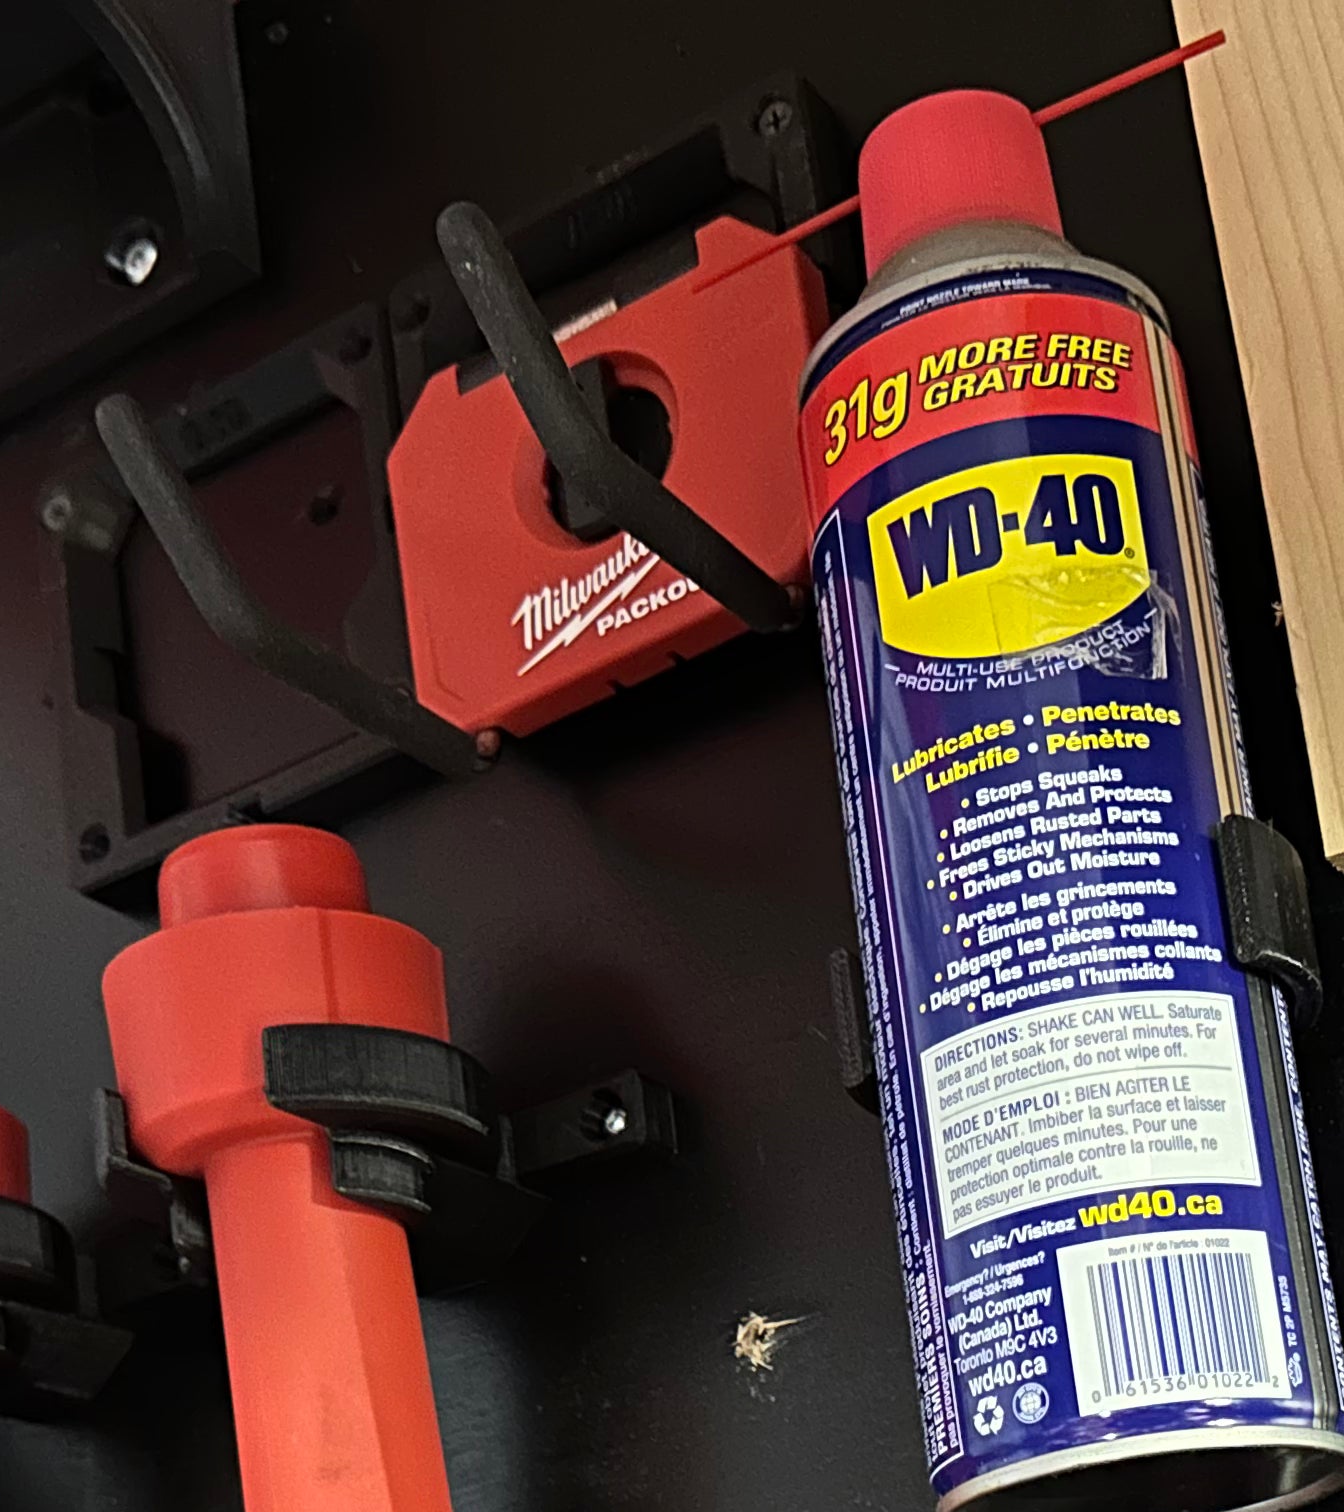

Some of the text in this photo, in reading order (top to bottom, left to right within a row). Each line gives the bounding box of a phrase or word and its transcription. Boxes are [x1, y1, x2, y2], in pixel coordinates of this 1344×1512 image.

[918, 333, 1132, 384] MORE FREE
[923, 363, 1118, 411] GRATUITS
[825, 371, 909, 466] 31g
[886, 473, 1125, 599] WD-40
[895, 622, 1152, 693] PRODUIT MULTIFONCTION
[917, 619, 1125, 677] MULTI-USE PRODUCT
[892, 701, 1182, 783] Lubricates Penetrates
[925, 728, 1150, 793] Lubrifie Pénètre
[953, 785, 1173, 837] Removes And Protects
[976, 765, 1123, 807] Stops Squeaks
[939, 827, 1179, 888] Frees Sticky Mechanisms
[950, 806, 1162, 860] Loosens Rusted Parts
[956, 878, 1177, 933] Arrête les grincements
[963, 852, 1160, 900] Drives Out Moisture
[947, 920, 1198, 980] Dégage les pièces rouillées
[978, 900, 1144, 946] Élimine et protège
[930, 941, 1223, 1012] Dégage les mécanismes collants
[982, 962, 1175, 1012] Repousse l'humidité
[935, 1002, 1222, 1072] DIRECTIONS: SHAKE CAN WELL. Saturate
[937, 1024, 1217, 1092] area and let soak for several minutes. For
[940, 1042, 1187, 1111] best rust protection, do not wipe off.
[942, 1114, 980, 1144] MODE
[984, 1091, 1060, 1127] D'EMPLOI
[1075, 1080, 1111, 1101] BIEN
[1116, 1077, 1169, 1098] AGITER
[1172, 1076, 1191, 1092] LE
[945, 1093, 1226, 1163] CONTENANT. Imbiber la surface et laisser
[948, 1117, 1197, 1184] tremper quelques minutes. Pour une
[951, 1136, 1218, 1204] protection optimale contre la rouille, ne
[953, 1164, 1102, 1223] pas essuyer le produit.
[907, 1198, 921, 1254] Contient
[969, 1189, 1223, 1259] Visit/Visitez wd40.ca
[995, 1251, 1045, 1276] Urgences?
[1314, 1233, 1331, 1283] MAY
[914, 1271, 933, 1338] SOINS
[948, 1286, 1052, 1335] WD-40 Company
[959, 1309, 1043, 1355] (Canada) Ltd.
[921, 1238, 959, 1448] pas provoquer le vomissement.
[954, 1326, 1058, 1375] Toronto M9C 4V3
[1287, 1332, 1297, 1347] TC
[923, 1343, 949, 1455] PREMIERS
[968, 1355, 1047, 1397] wd40.ca
